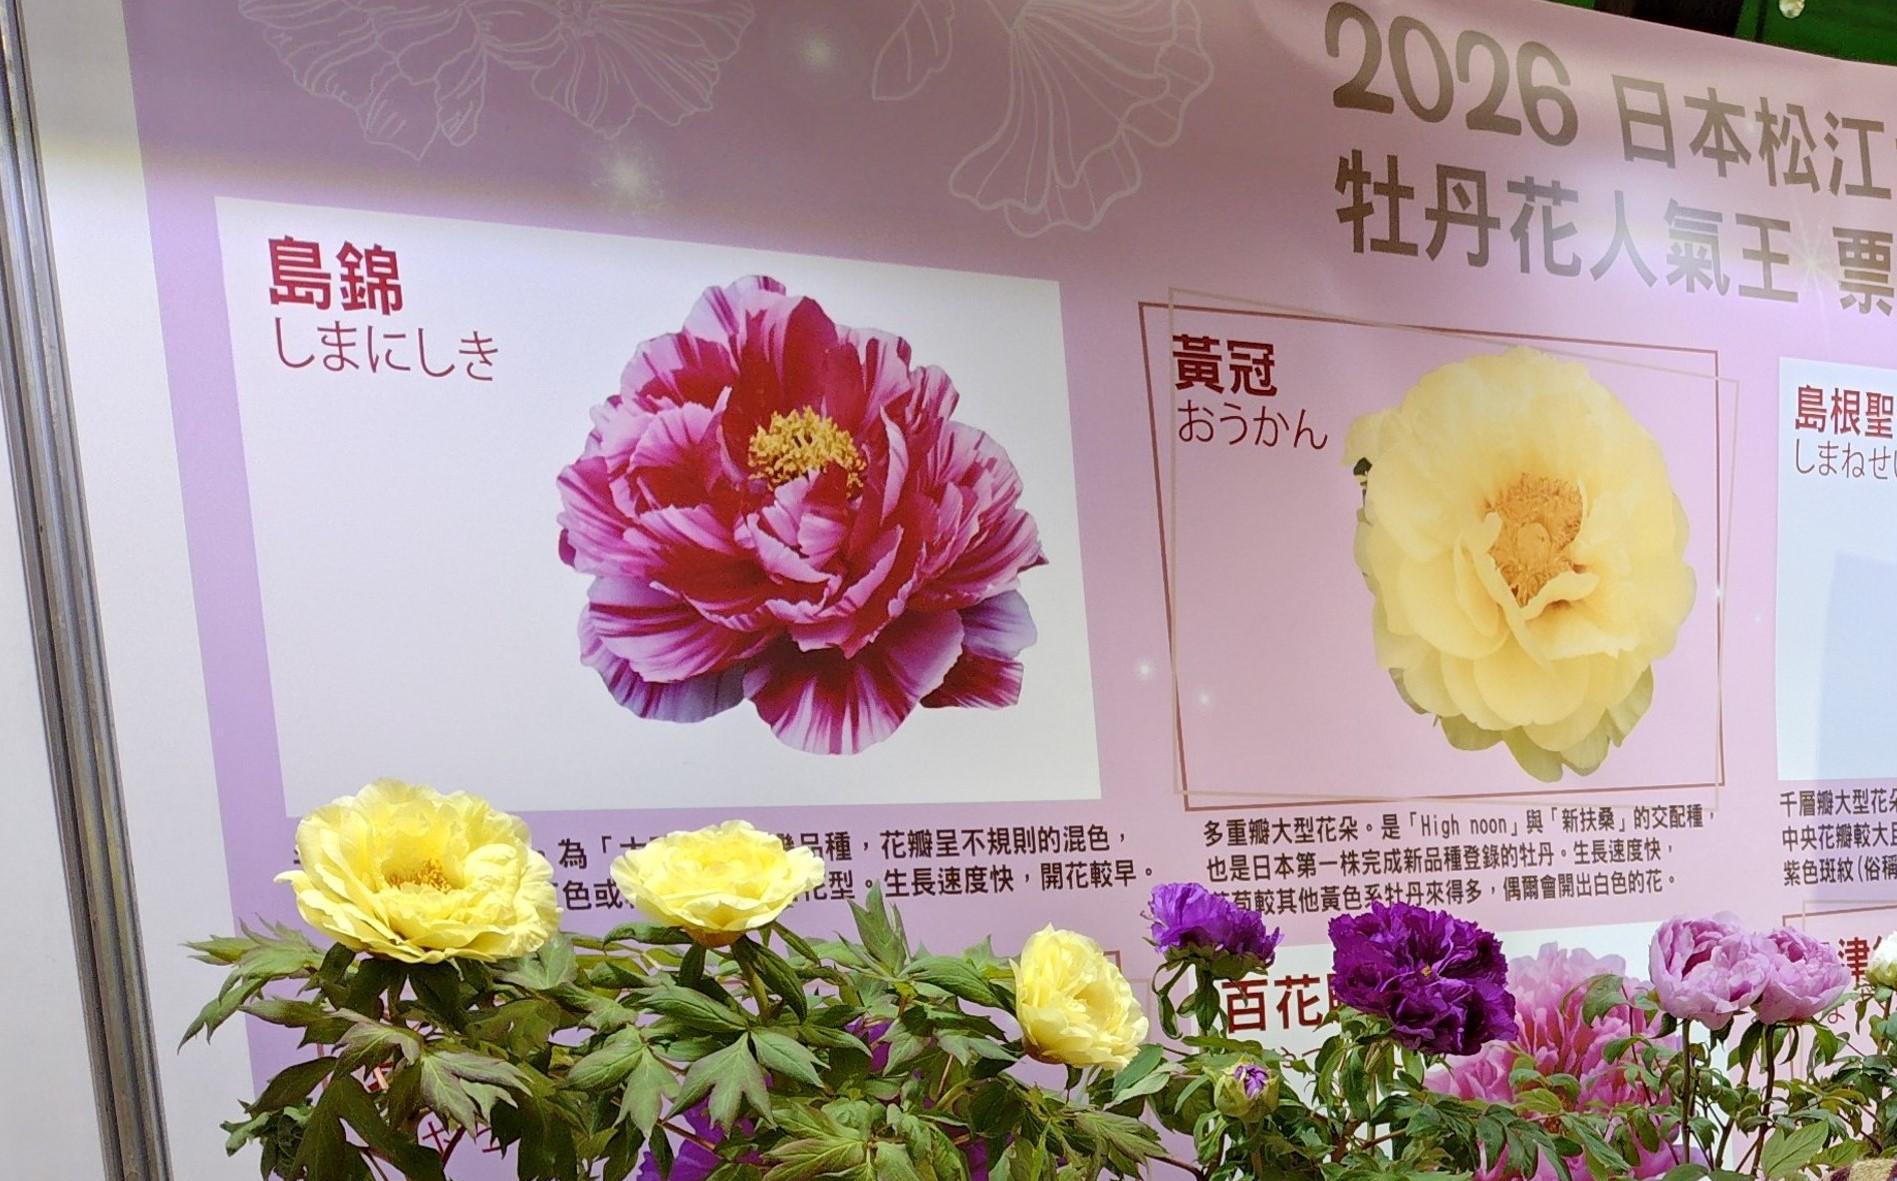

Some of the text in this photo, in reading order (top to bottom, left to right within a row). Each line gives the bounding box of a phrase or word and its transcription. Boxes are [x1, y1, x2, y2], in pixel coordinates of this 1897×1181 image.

[1324, 1, 1581, 147] 2026
[1334, 148, 1800, 304] 牡丹花人氣王
[268, 235, 403, 316] 島錦
[275, 316, 499, 381] しまにしき
[1177, 399, 1328, 450] おうかん
